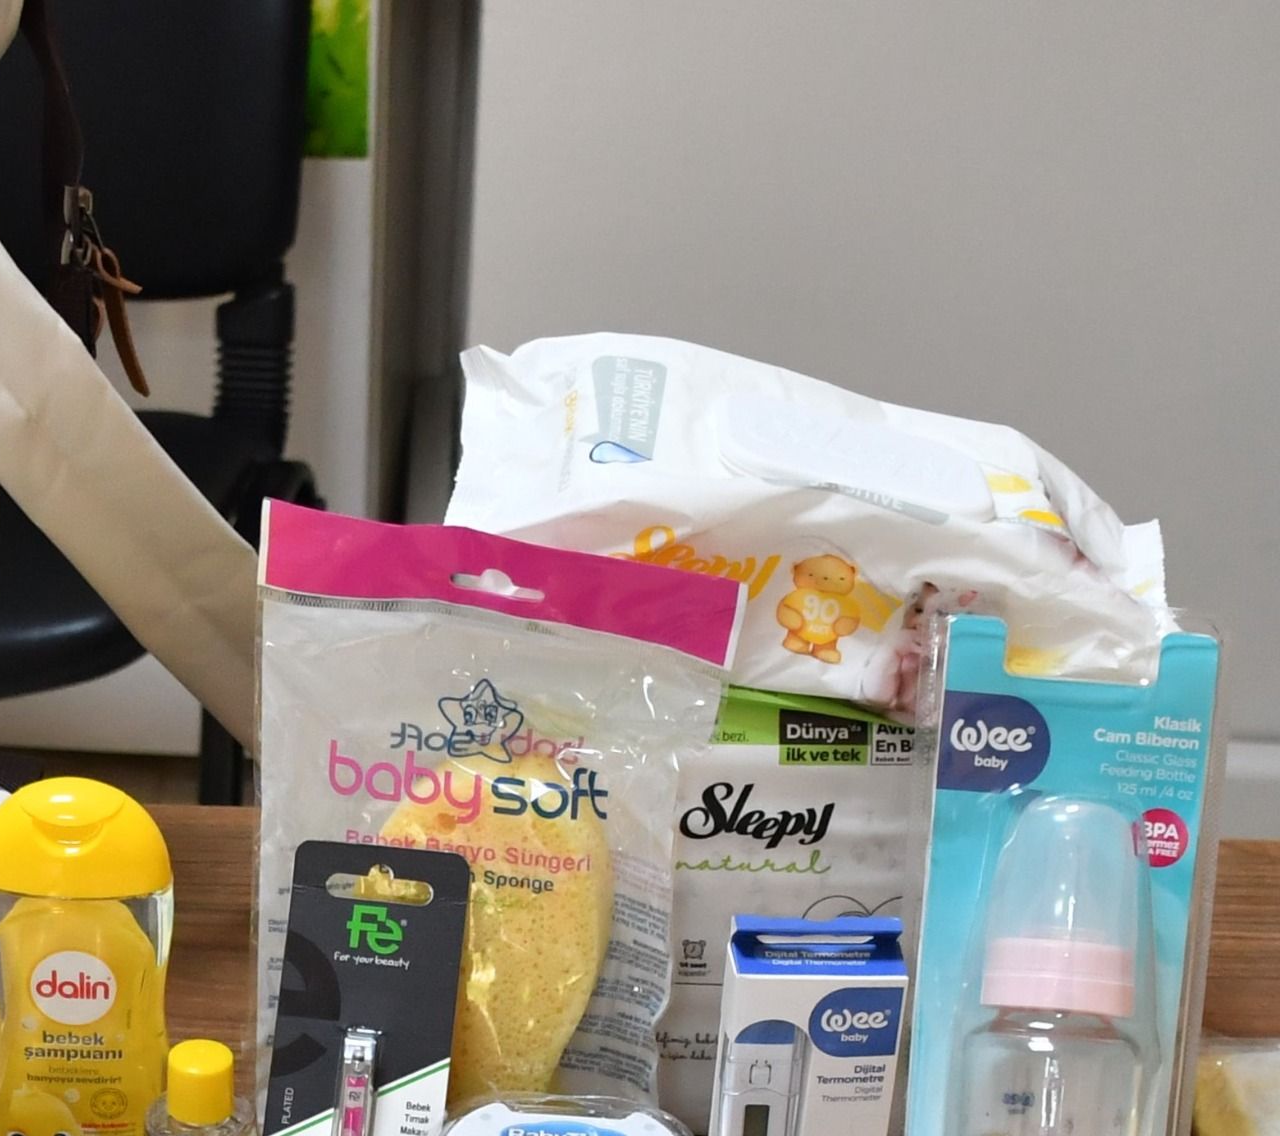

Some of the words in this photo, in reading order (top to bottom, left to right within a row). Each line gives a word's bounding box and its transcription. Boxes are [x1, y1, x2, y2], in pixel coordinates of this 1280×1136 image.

[803, 595, 840, 623] 90
[1154, 717, 1201, 733] Klasik
[876, 740, 896, 752] En
[1094, 728, 1131, 743] Cam
[1135, 730, 1198, 749] Biberon
[786, 747, 806, 761] ilk
[809, 751, 829, 761] ve
[832, 748, 860, 762] tek
[974, 754, 1008, 771] baby
[1116, 750, 1159, 765] Classic
[329, 739, 482, 824] baby
[492, 767, 608, 820] soft
[679, 782, 835, 849] Sleepy
[675, 849, 831, 874] natural
[483, 871, 554, 893] Sponge
[334, 951, 349, 961] For
[352, 956, 373, 965] your
[375, 956, 410, 970] beauty
[35, 971, 111, 1001] dalin
[42, 1030, 104, 1045] bebek
[841, 1032, 868, 1043] baby
[24, 1046, 123, 1061] şampuanı
[854, 1064, 886, 1074] Dijital
[816, 1075, 884, 1084] Termometre
[854, 1086, 883, 1095] Digital
[281, 1087, 295, 1125] PLATED
[406, 1101, 431, 1112] Bebek
